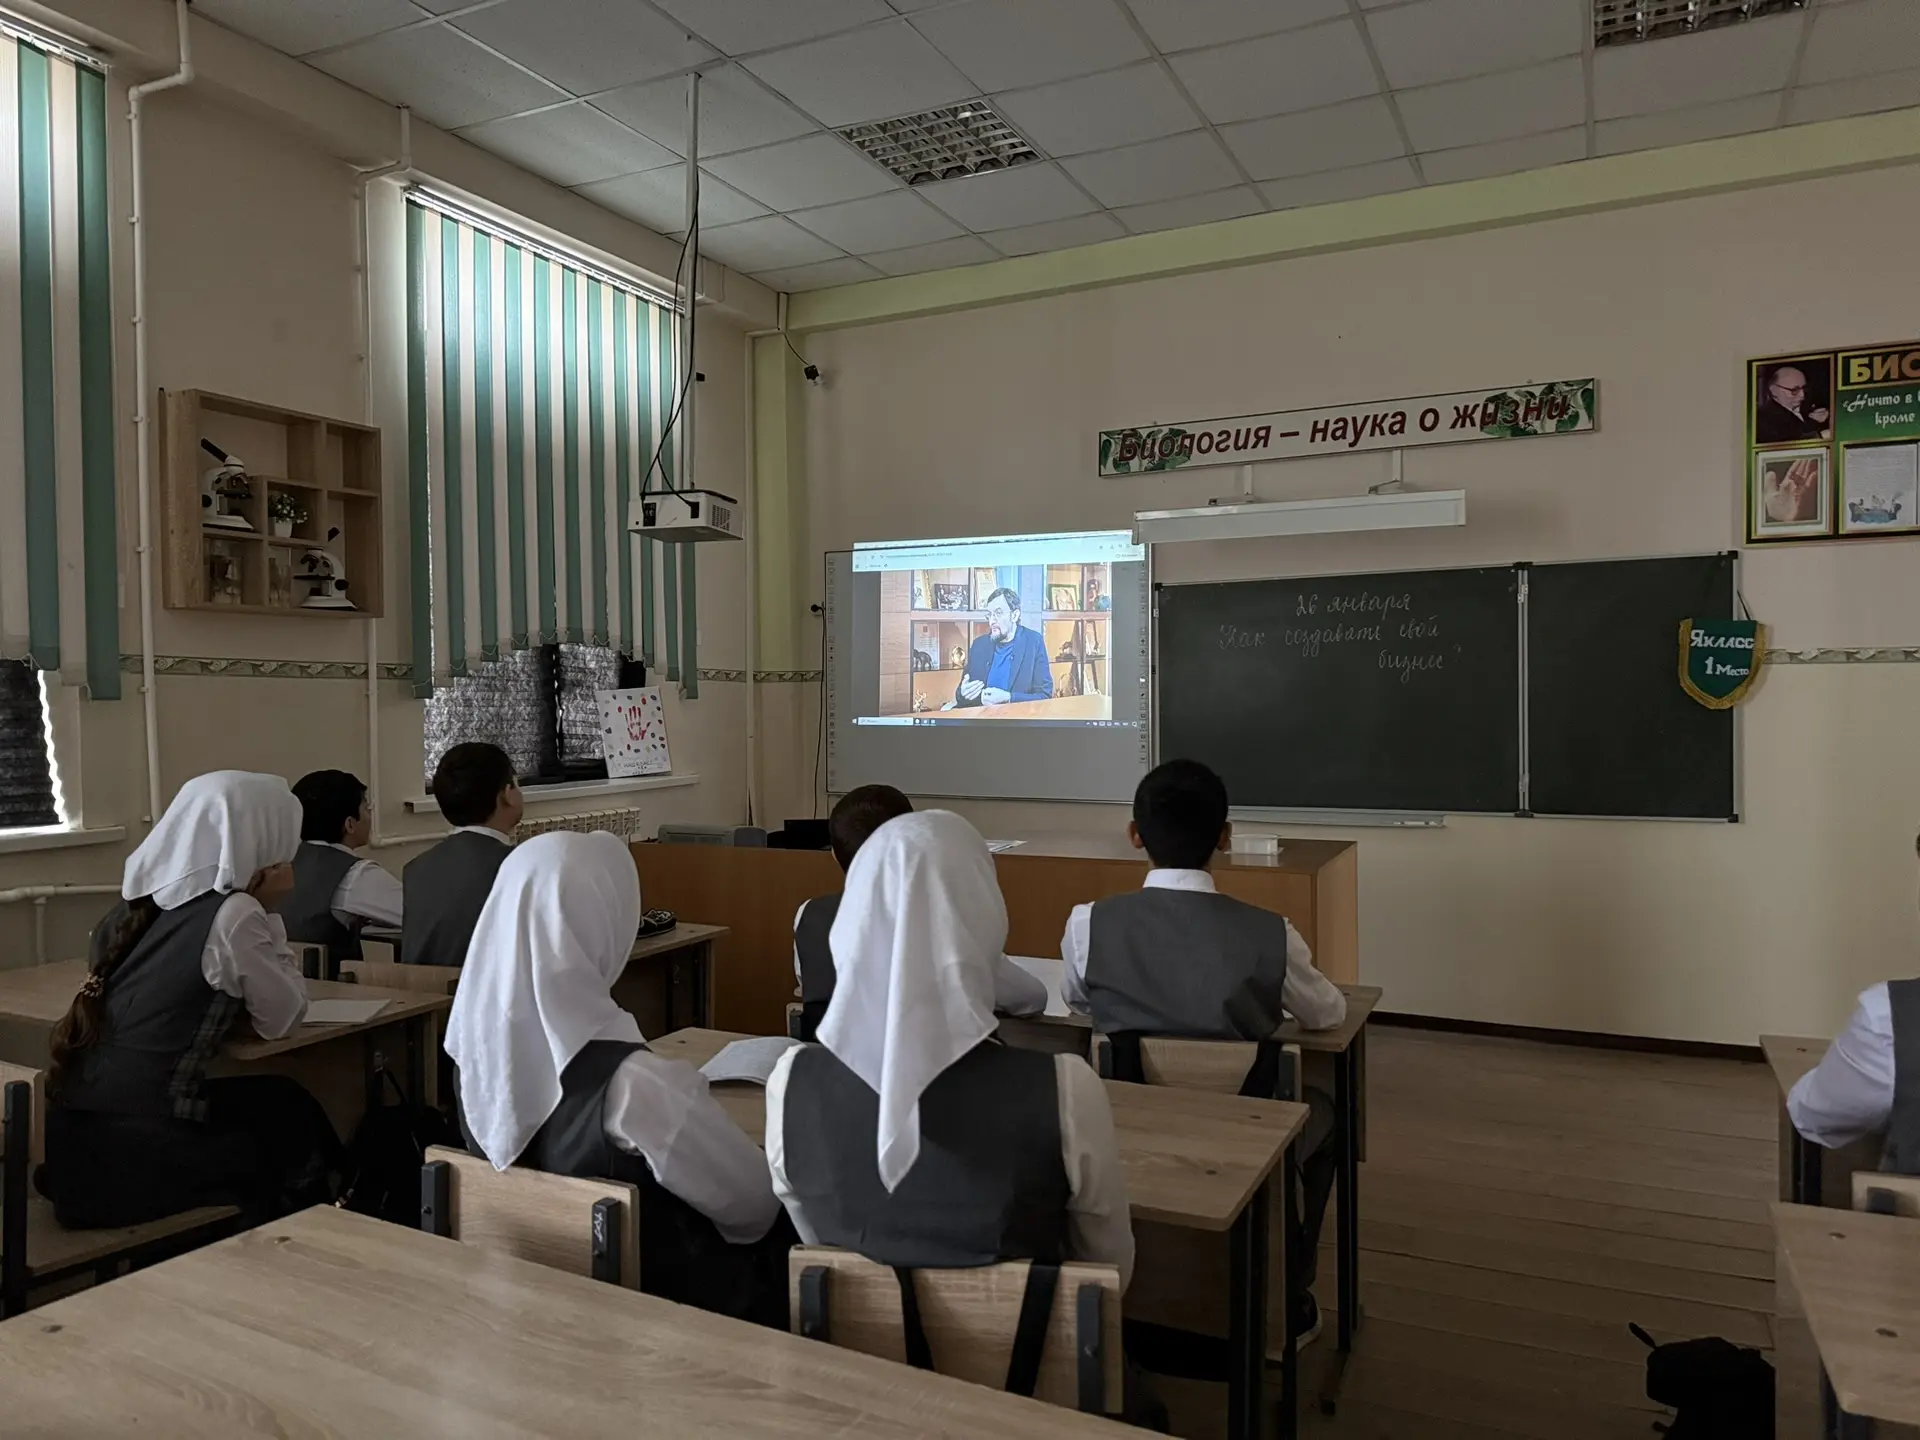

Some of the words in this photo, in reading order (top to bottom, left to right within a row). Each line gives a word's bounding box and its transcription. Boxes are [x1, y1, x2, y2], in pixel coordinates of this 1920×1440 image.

[1905, 393, 1912, 404] в
[1119, 425, 1271, 462] Биология
[1309, 409, 1407, 447] наука
[1419, 405, 1440, 432] о
[1450, 393, 1570, 429] жизни
[1875, 411, 1916, 429] кроме
[1297, 594, 1318, 616] 26
[1327, 592, 1411, 619] января
[1704, 656, 1714, 675] 1
